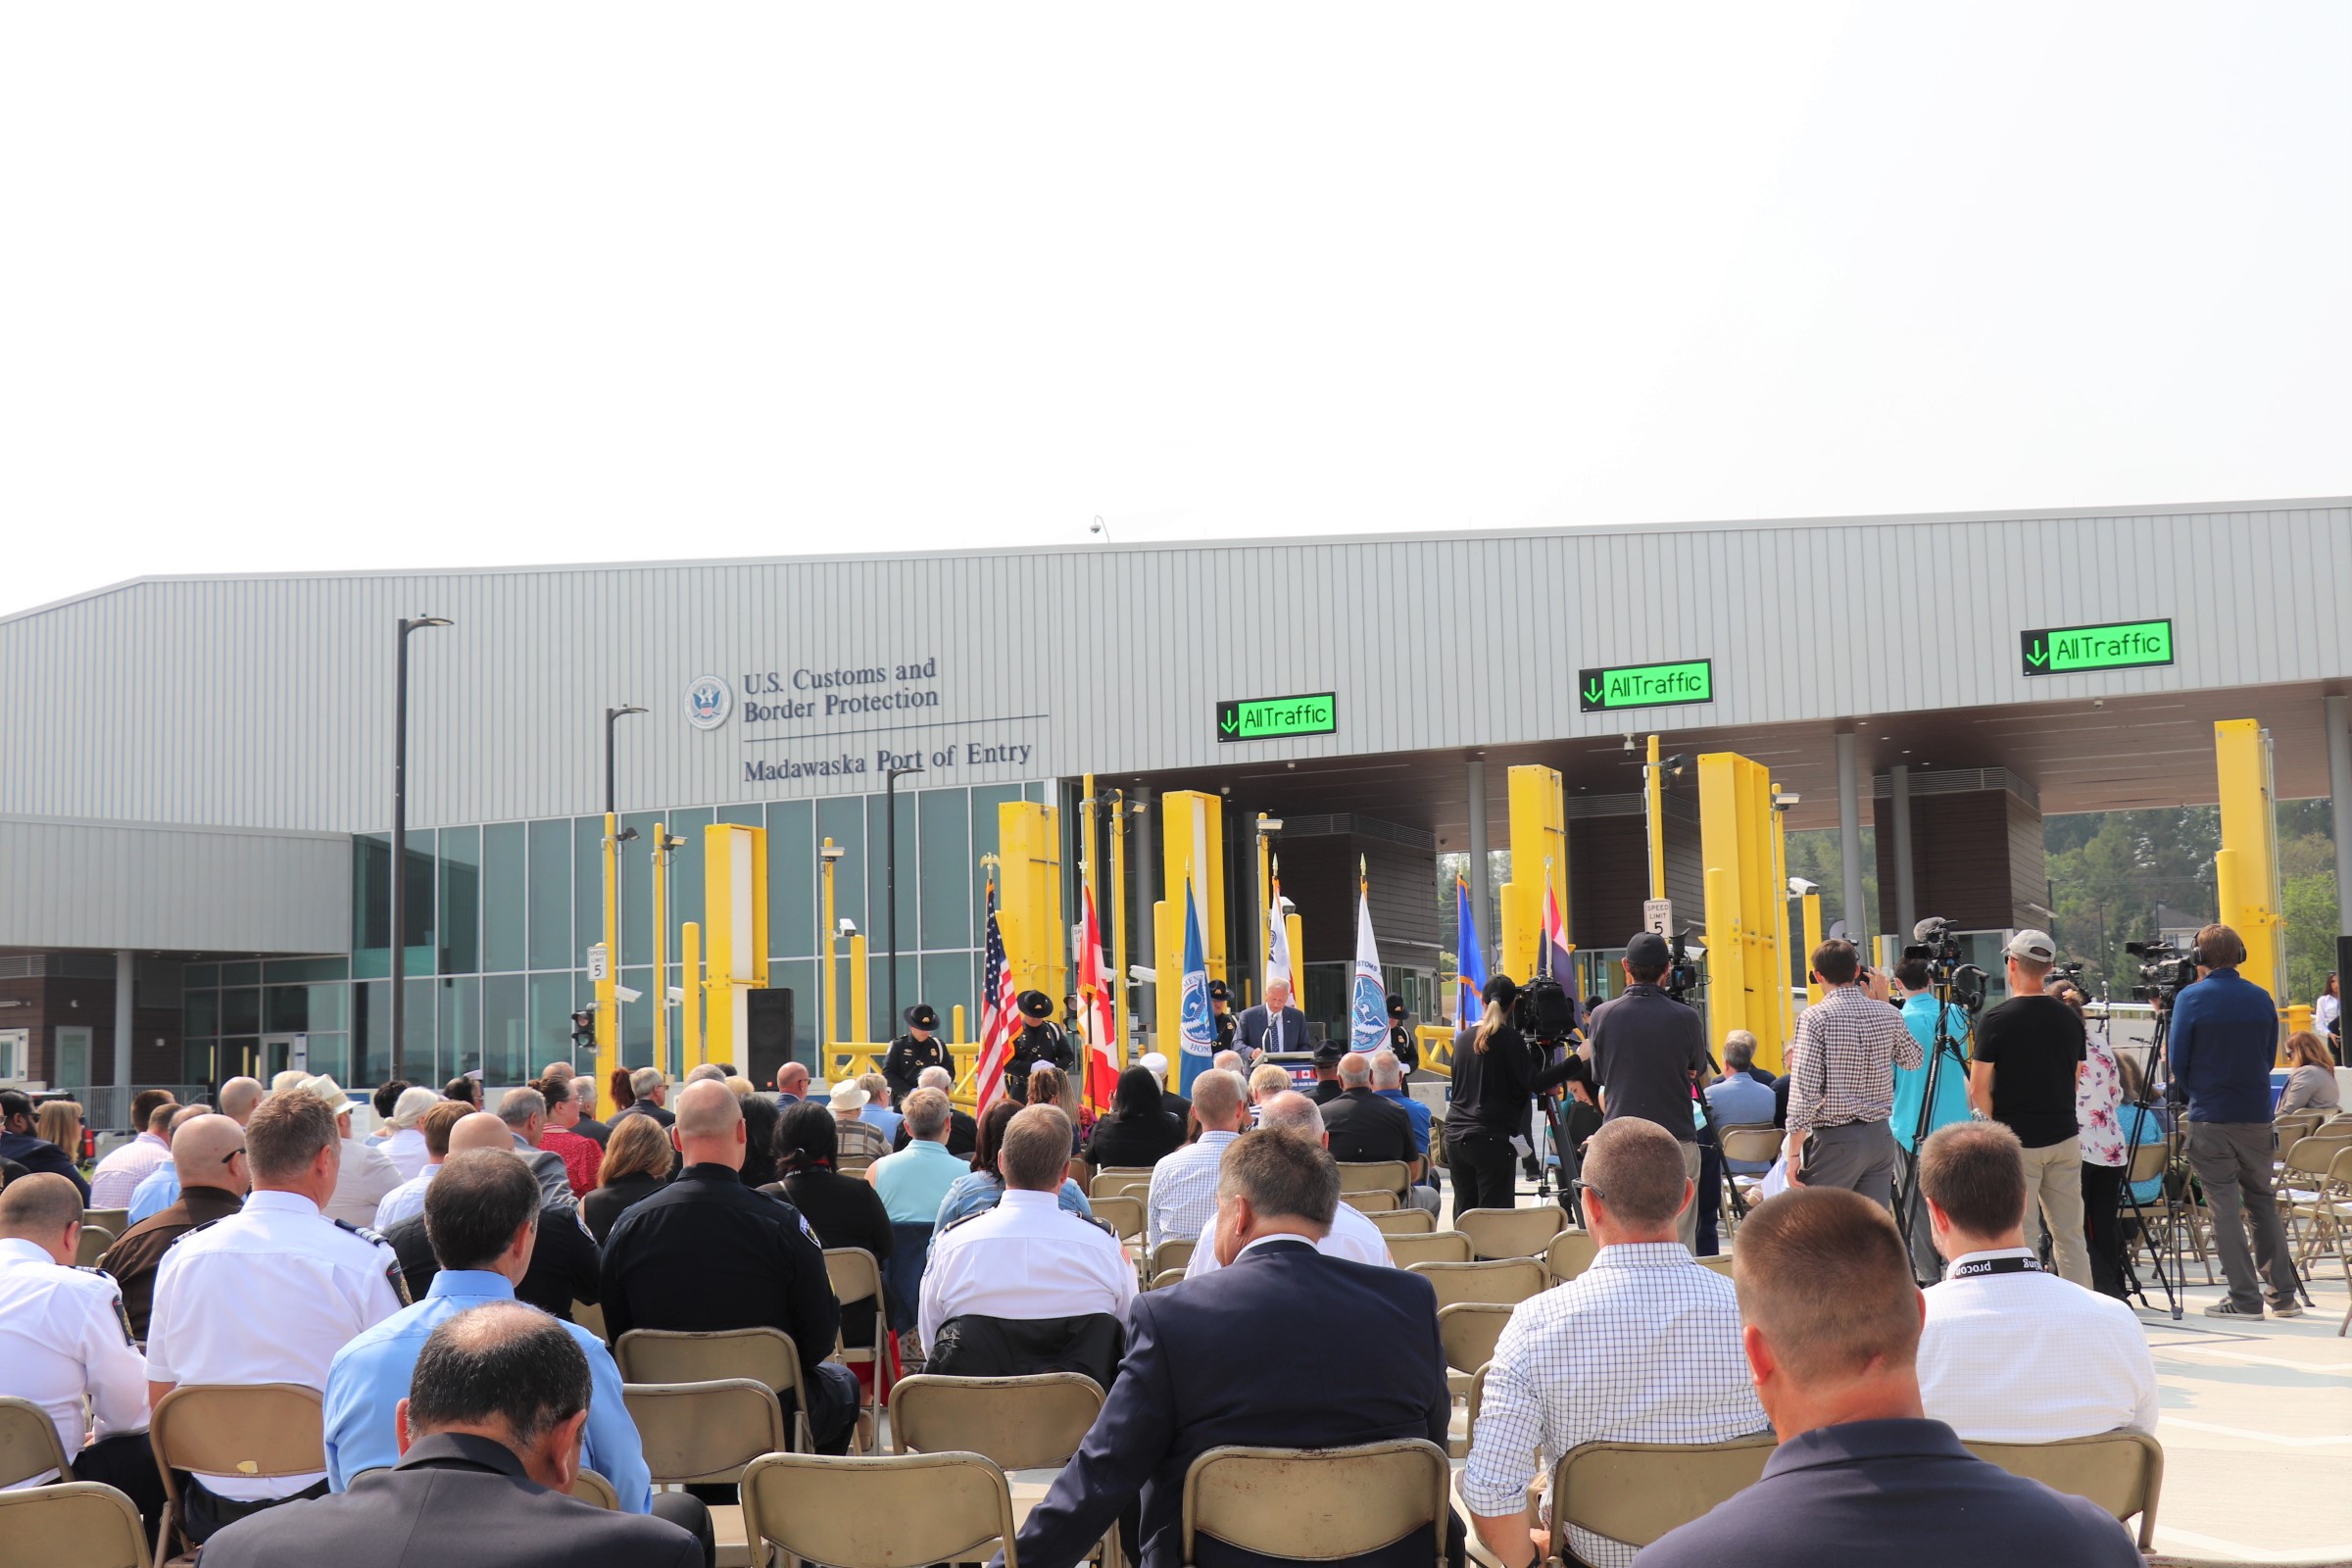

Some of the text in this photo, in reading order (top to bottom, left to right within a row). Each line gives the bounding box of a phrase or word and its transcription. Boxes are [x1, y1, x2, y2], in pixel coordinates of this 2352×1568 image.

[743, 657, 936, 695] U.S. Customs and
[743, 699, 815, 722] Border
[824, 687, 939, 715] Protection
[744, 742, 1032, 782] Madawaska Port of Entry
[1654, 921, 1663, 935] 5
[594, 964, 602, 977] 5
